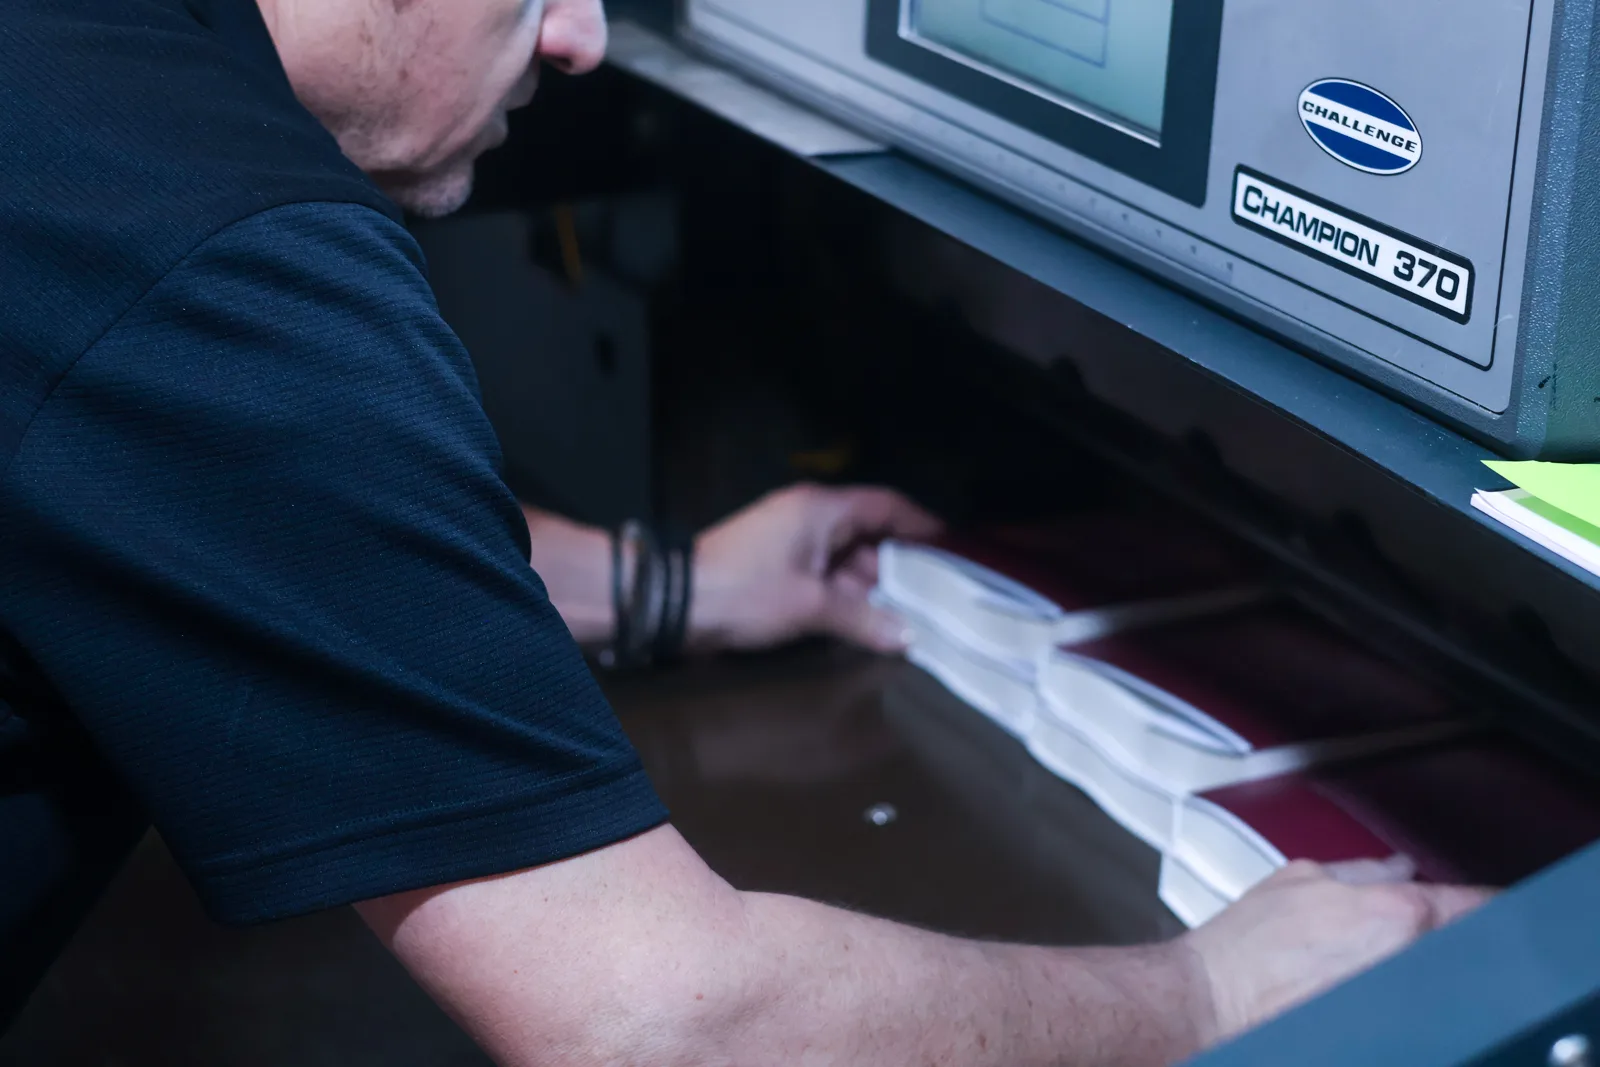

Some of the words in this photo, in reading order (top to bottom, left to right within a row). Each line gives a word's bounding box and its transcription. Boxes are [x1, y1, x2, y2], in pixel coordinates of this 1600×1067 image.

[1302, 101, 1418, 152] CHALLENGE
[1242, 185, 1380, 267] CHAMPION
[1393, 250, 1460, 301] 370
